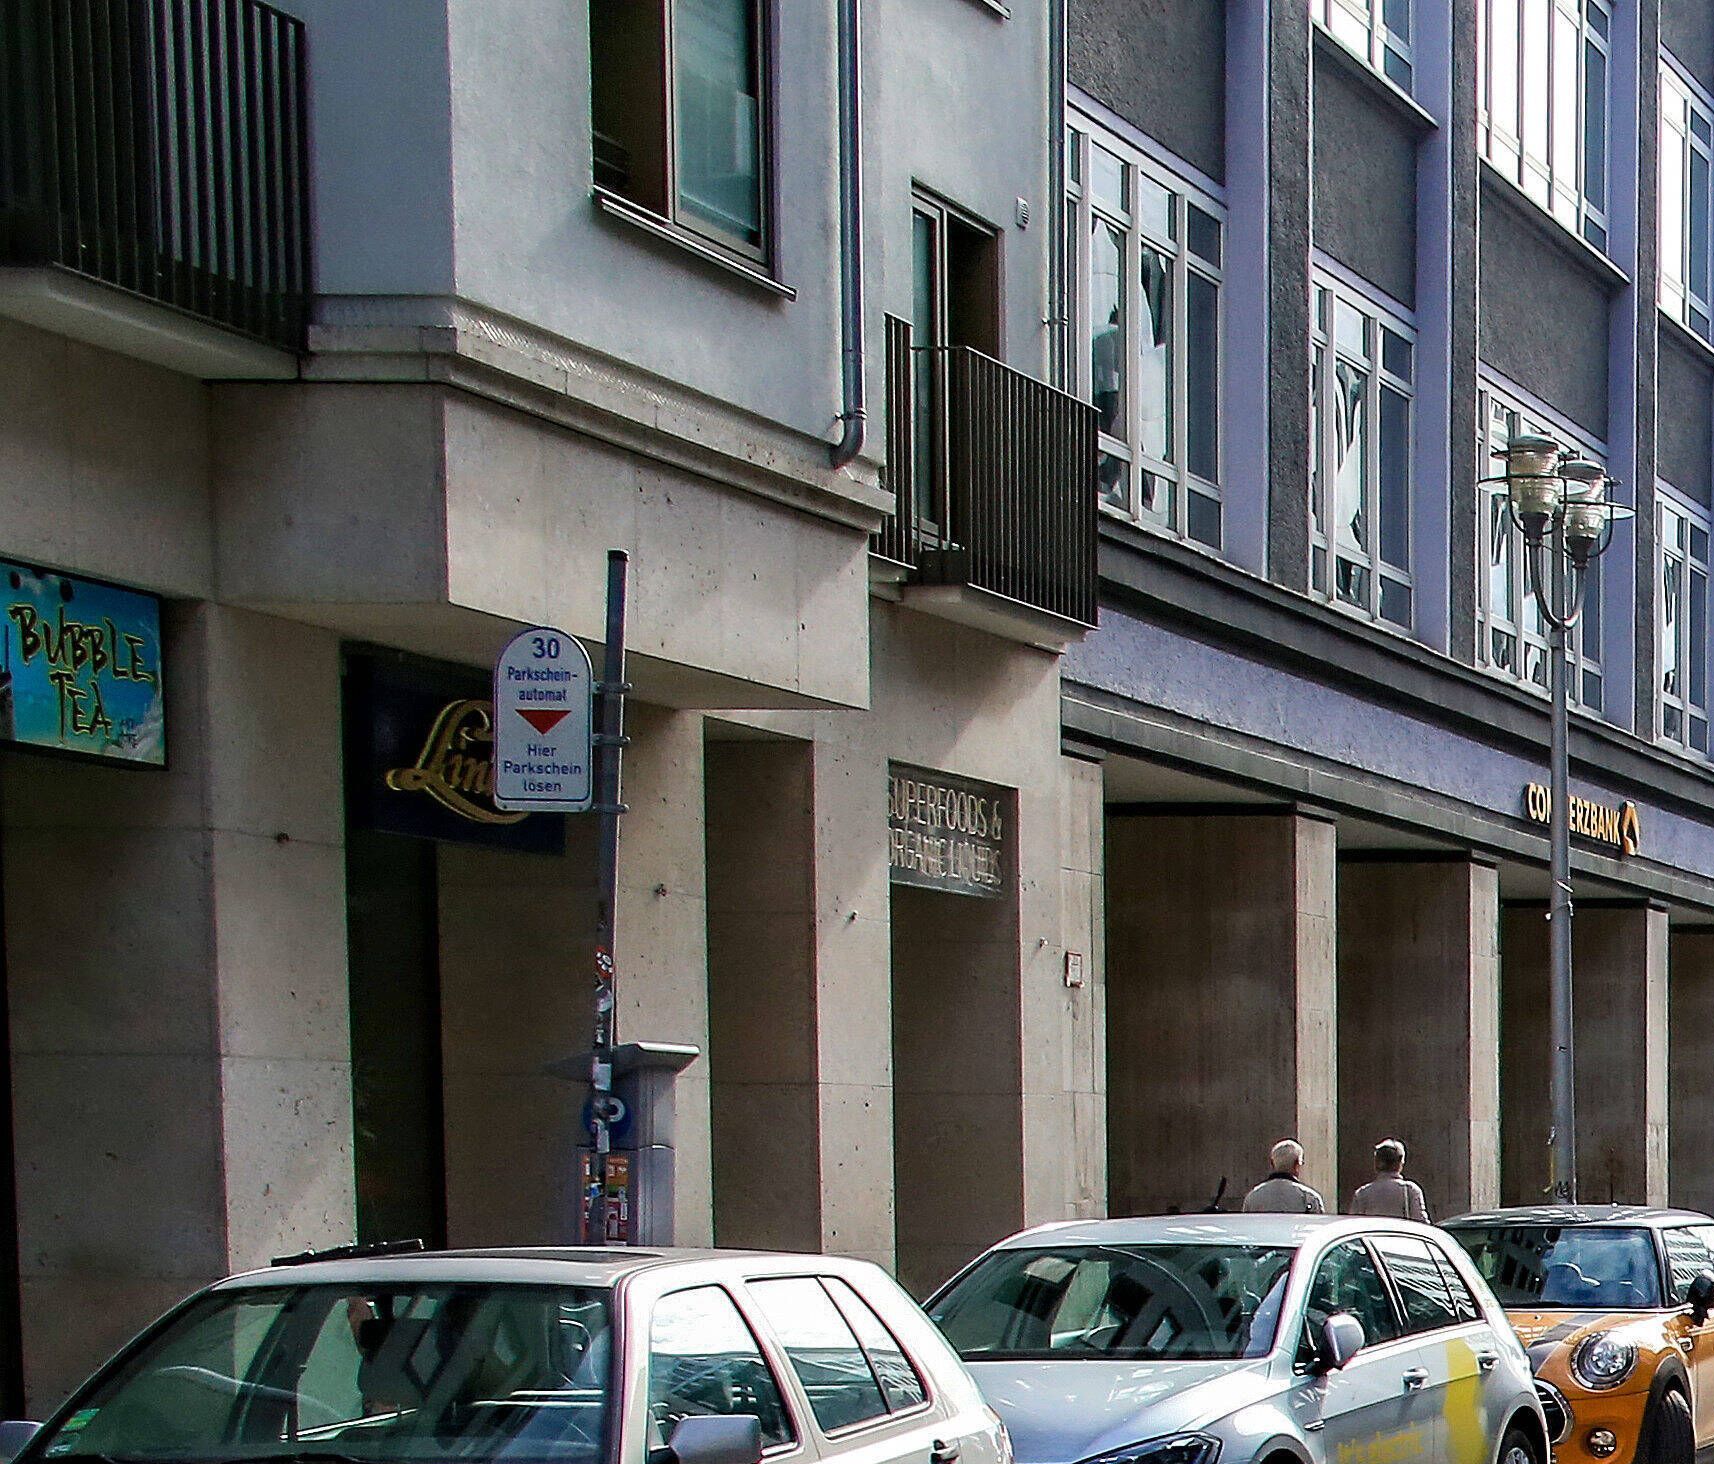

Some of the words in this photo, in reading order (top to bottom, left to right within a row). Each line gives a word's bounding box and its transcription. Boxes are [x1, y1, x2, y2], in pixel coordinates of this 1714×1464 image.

[8, 604, 154, 682] BUBBLE
[532, 638, 560, 659] 30
[508, 667, 578, 681] Parkschein-
[518, 689, 568, 701] automat
[49, 671, 113, 744] TEA
[528, 744, 557, 757] Hier
[385, 699, 531, 824] Lin
[504, 760, 582, 775] Parkschein
[1528, 782, 1620, 845] COERZBANK
